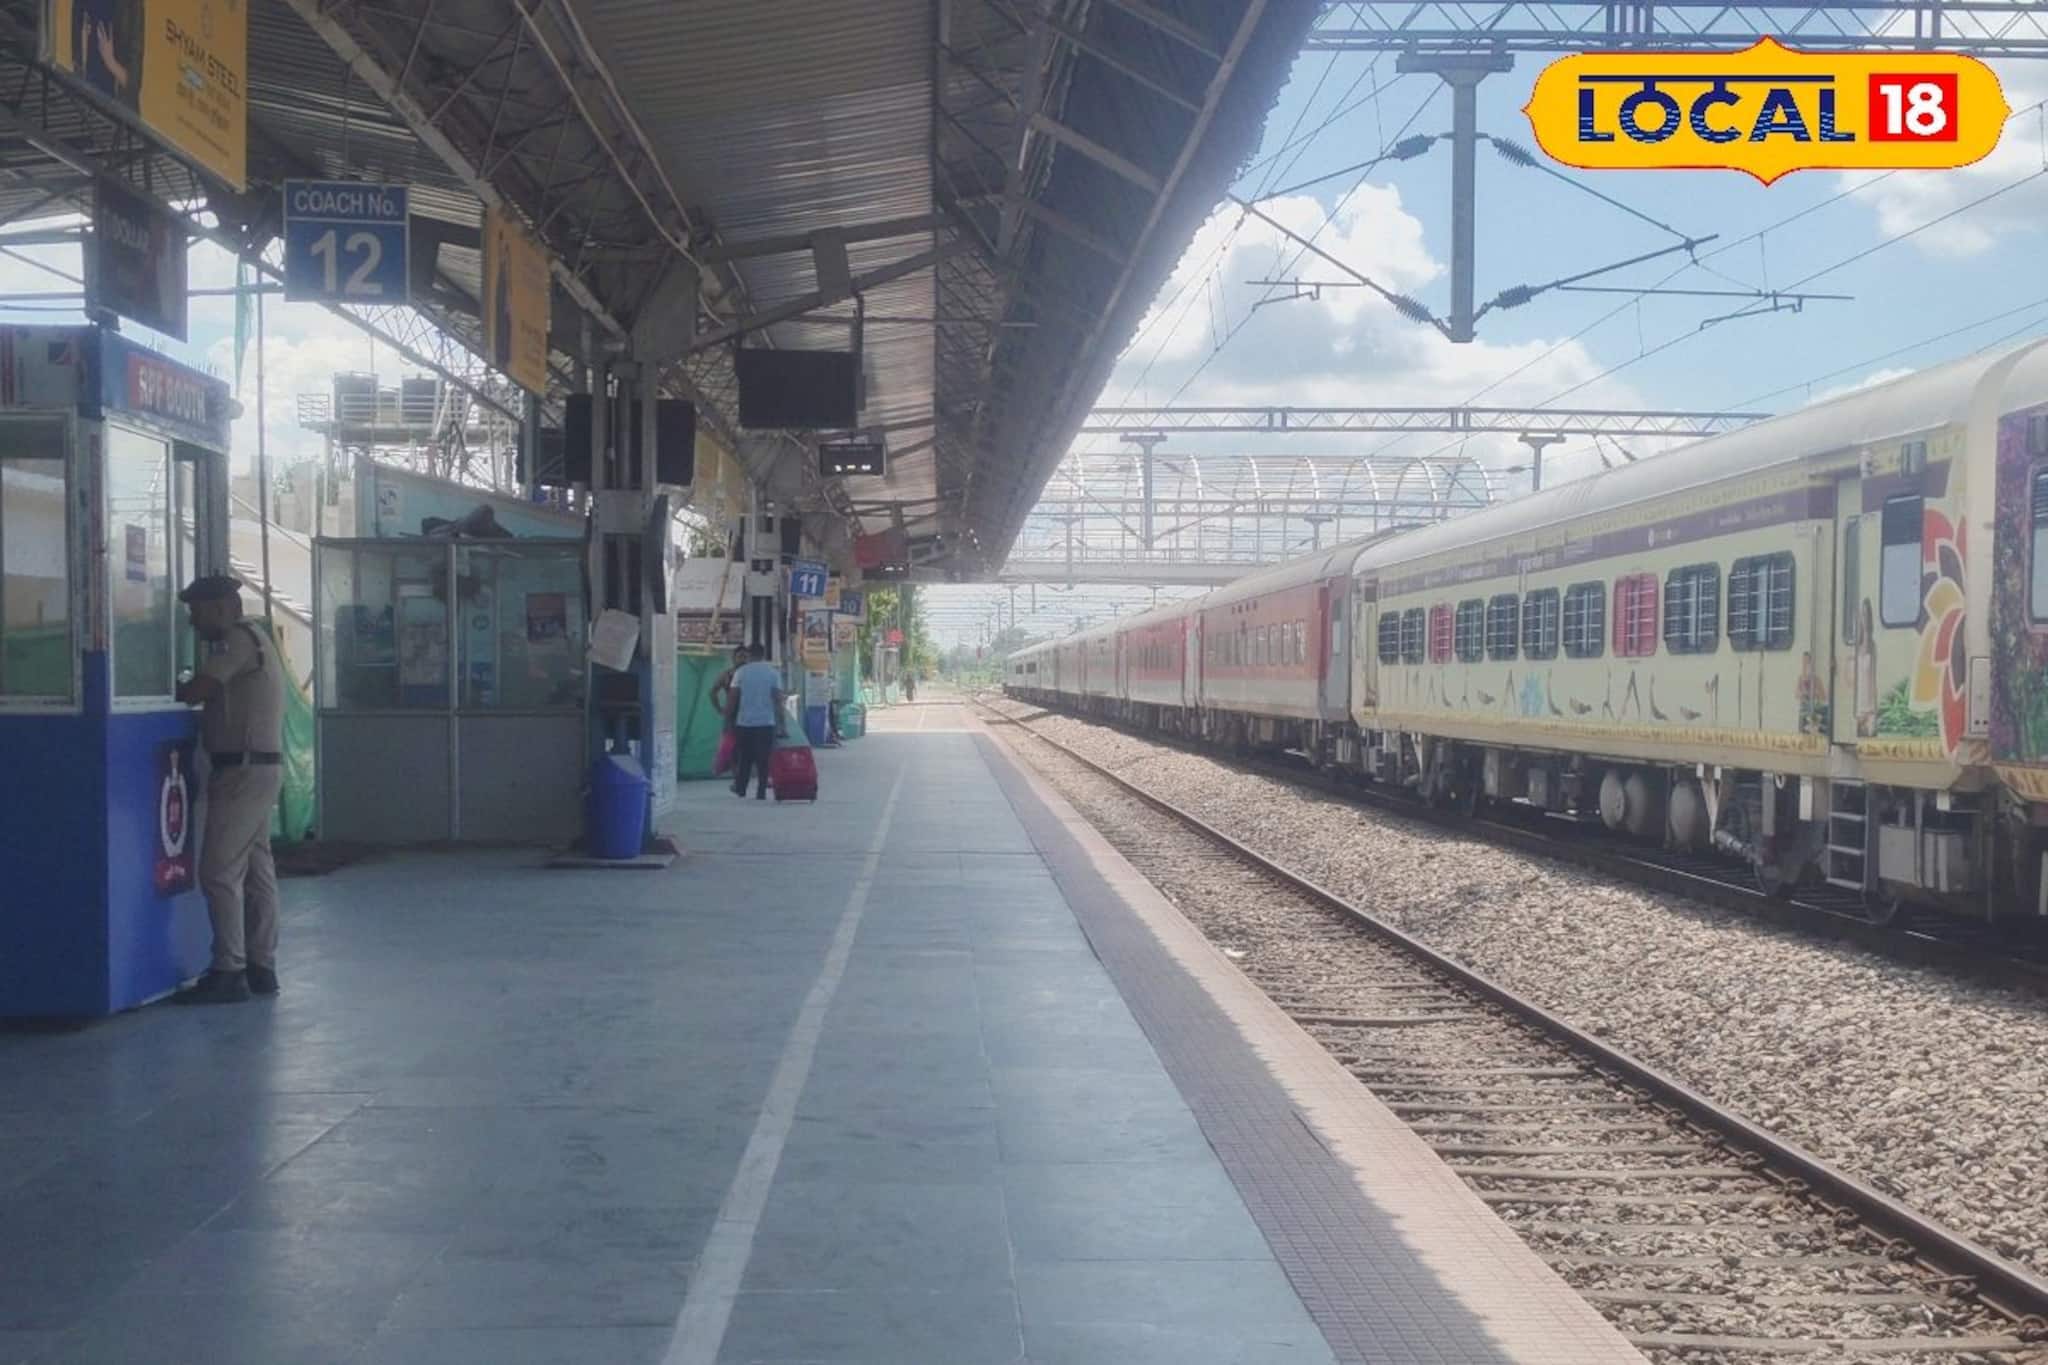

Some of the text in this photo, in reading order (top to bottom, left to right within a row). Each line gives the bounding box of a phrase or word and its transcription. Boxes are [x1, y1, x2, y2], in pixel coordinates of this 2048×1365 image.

[165, 17, 241, 98] SHYAM STEEL
[294, 189, 400, 217] COACH No.
[309, 230, 384, 296] 12
[799, 573, 819, 594] 11
